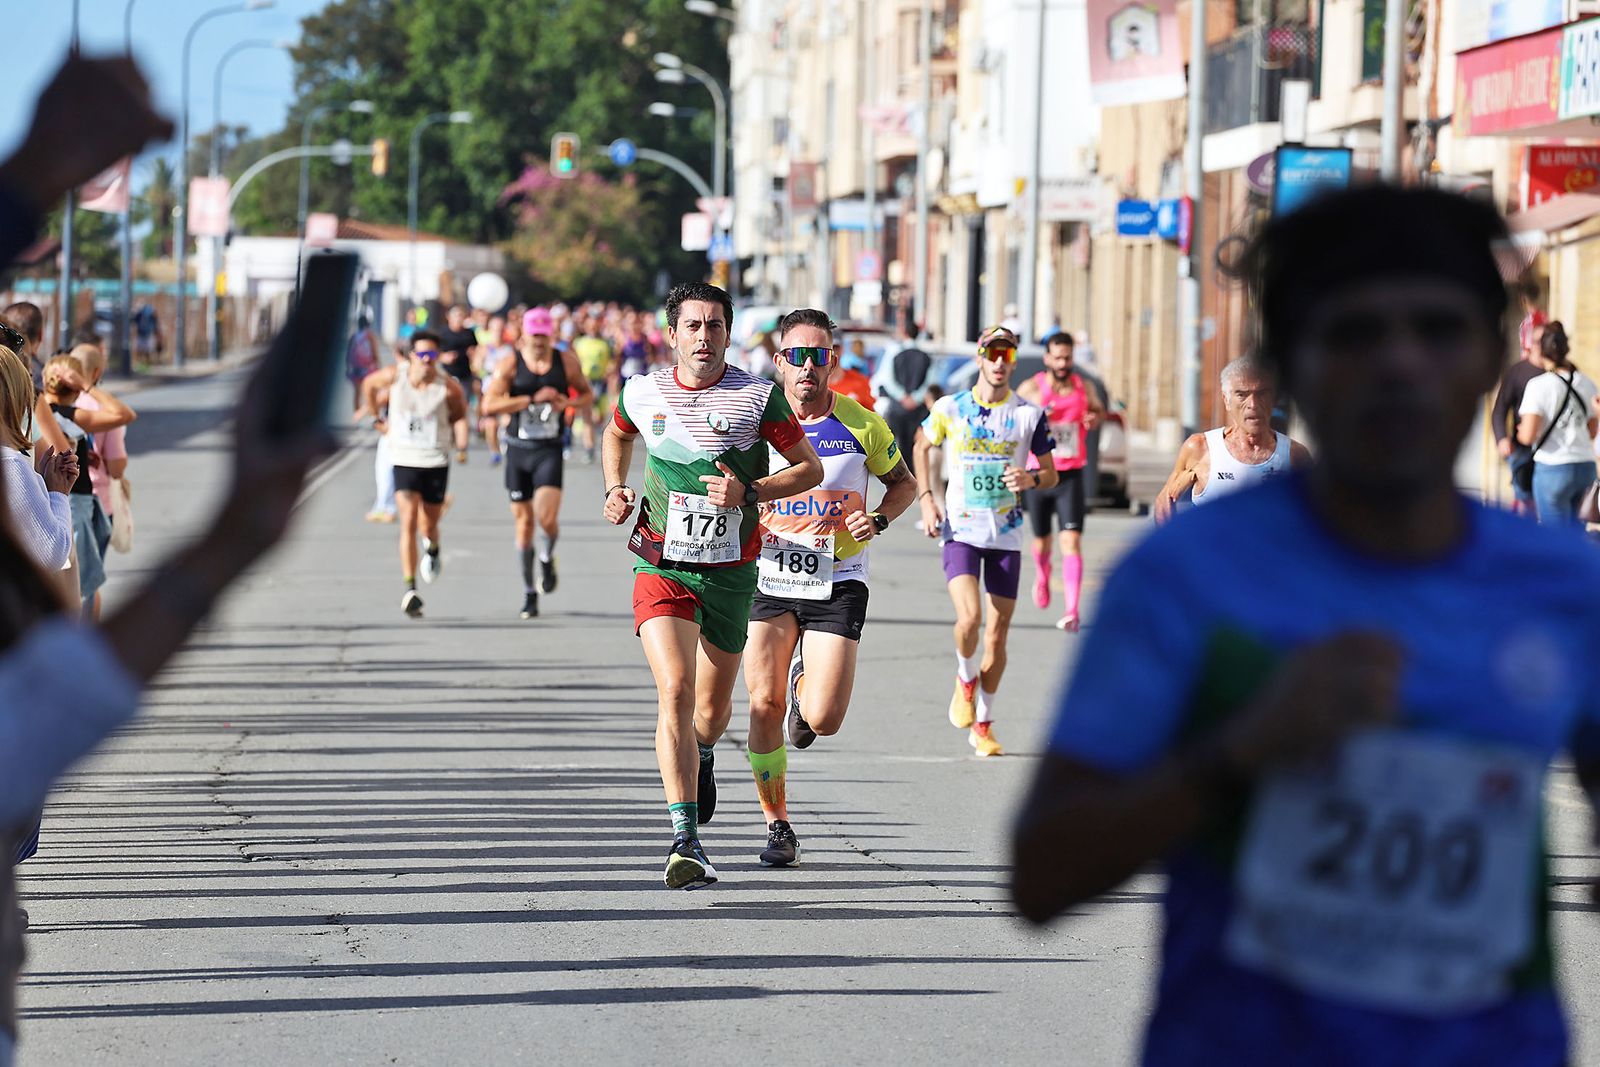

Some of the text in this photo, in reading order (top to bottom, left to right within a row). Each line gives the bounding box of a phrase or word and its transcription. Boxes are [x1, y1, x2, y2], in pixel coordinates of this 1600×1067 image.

[818, 440, 857, 449] AVATEL
[973, 475, 1006, 491] 635
[682, 513, 727, 538] 178
[670, 539, 705, 550] PEDROSA
[706, 541, 731, 550] TOLEDO
[766, 534, 780, 545] 2K
[814, 538, 829, 549] 2K
[774, 551, 819, 575] 189
[762, 576, 825, 587] ZARRIAS AGUILERA
